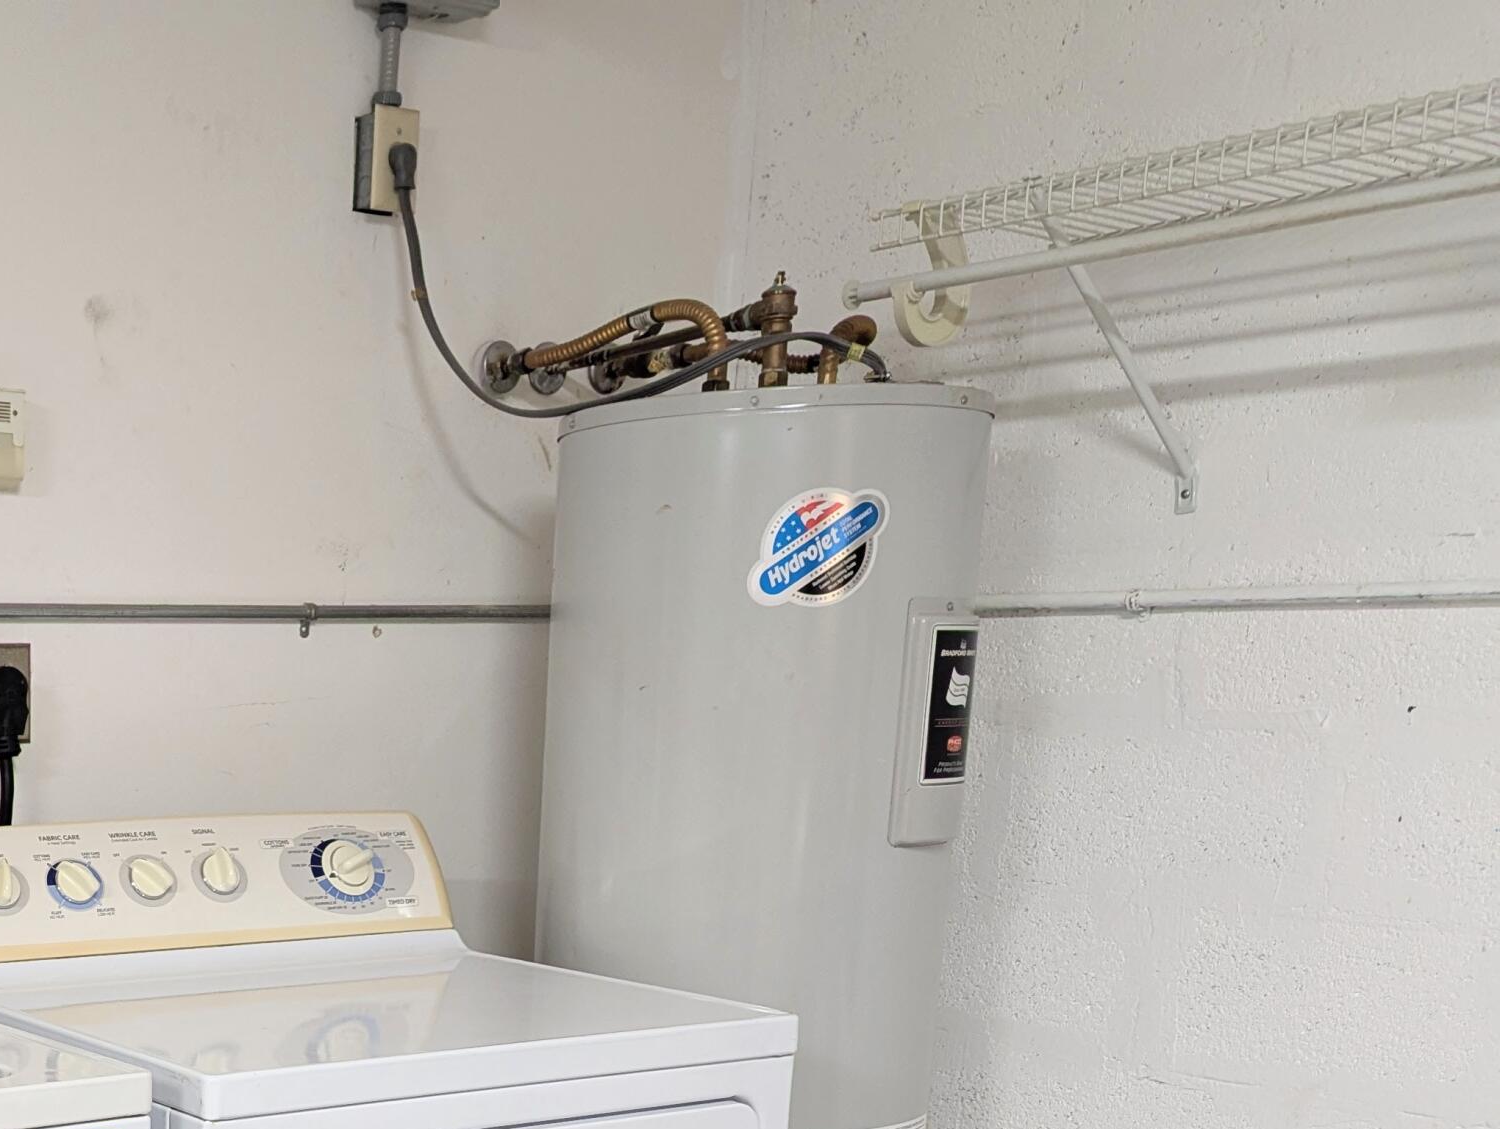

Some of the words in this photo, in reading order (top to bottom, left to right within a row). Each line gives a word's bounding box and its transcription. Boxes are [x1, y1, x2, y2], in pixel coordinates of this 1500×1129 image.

[766, 527, 841, 588] Hydrojet
[63, 833, 81, 841] CARE
[108, 831, 139, 839] WRINKLE
[139, 830, 157, 838] CARE
[263, 839, 290, 847] COTTONS
